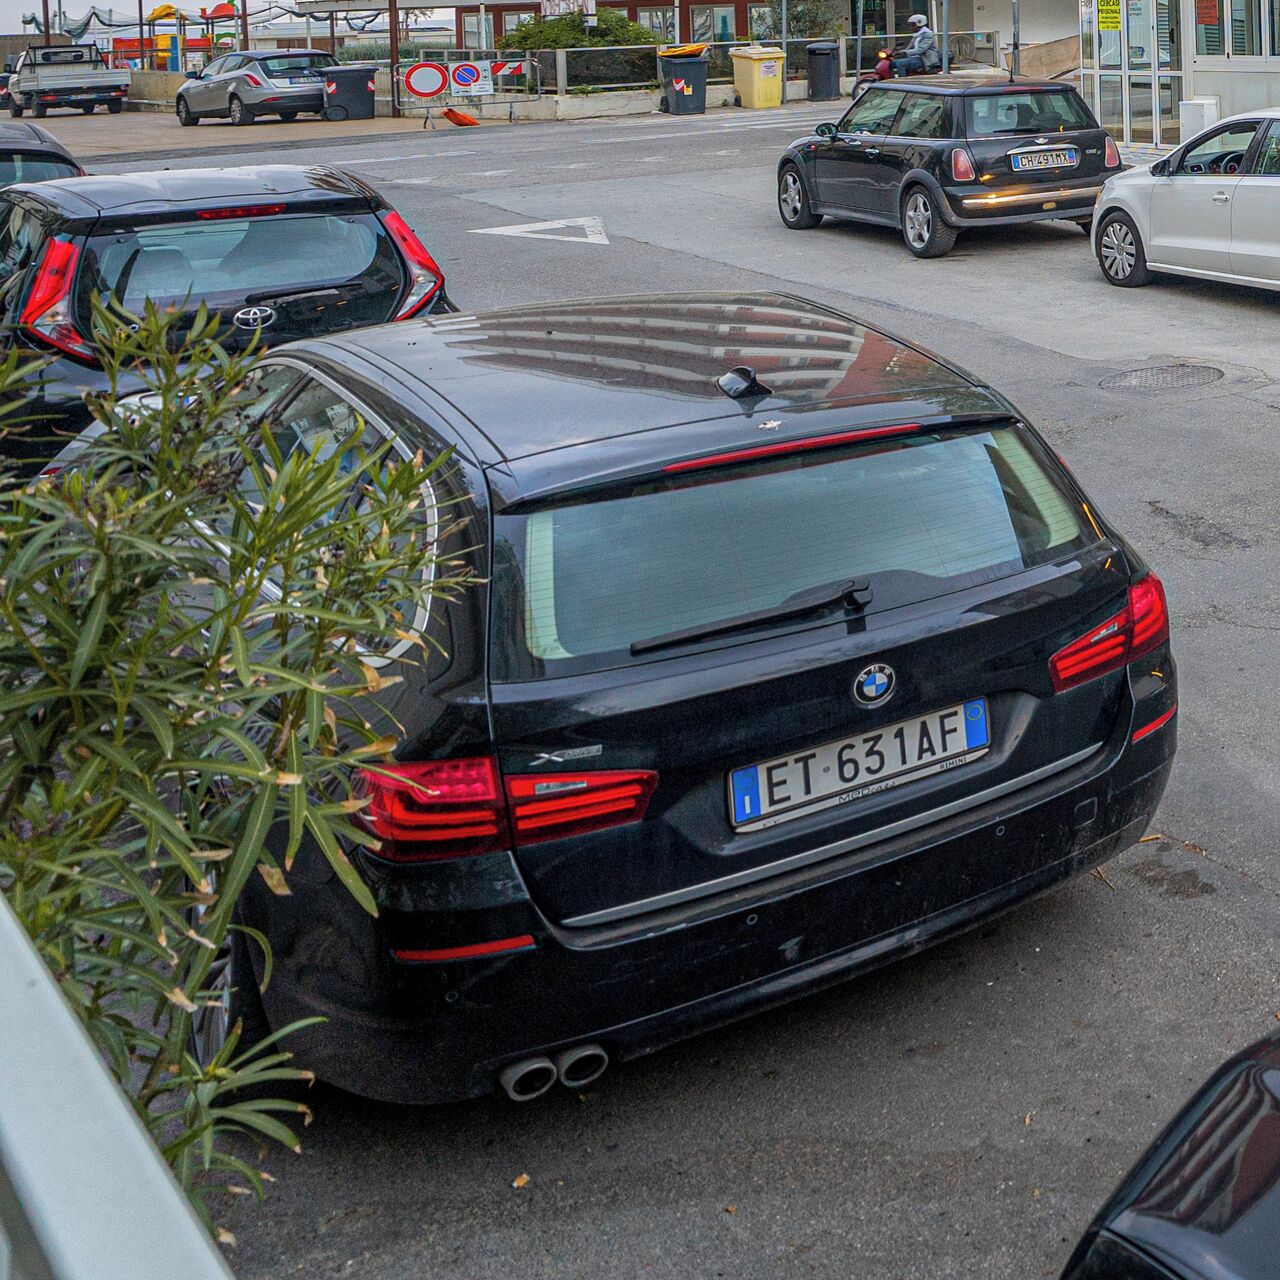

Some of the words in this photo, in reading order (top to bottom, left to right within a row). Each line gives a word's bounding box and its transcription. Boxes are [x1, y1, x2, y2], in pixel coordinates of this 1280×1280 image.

[1019, 154, 1034, 167] CH
[766, 752, 816, 806] ET
[837, 710, 959, 783] 631AF
[940, 756, 968, 770] RIMINI
